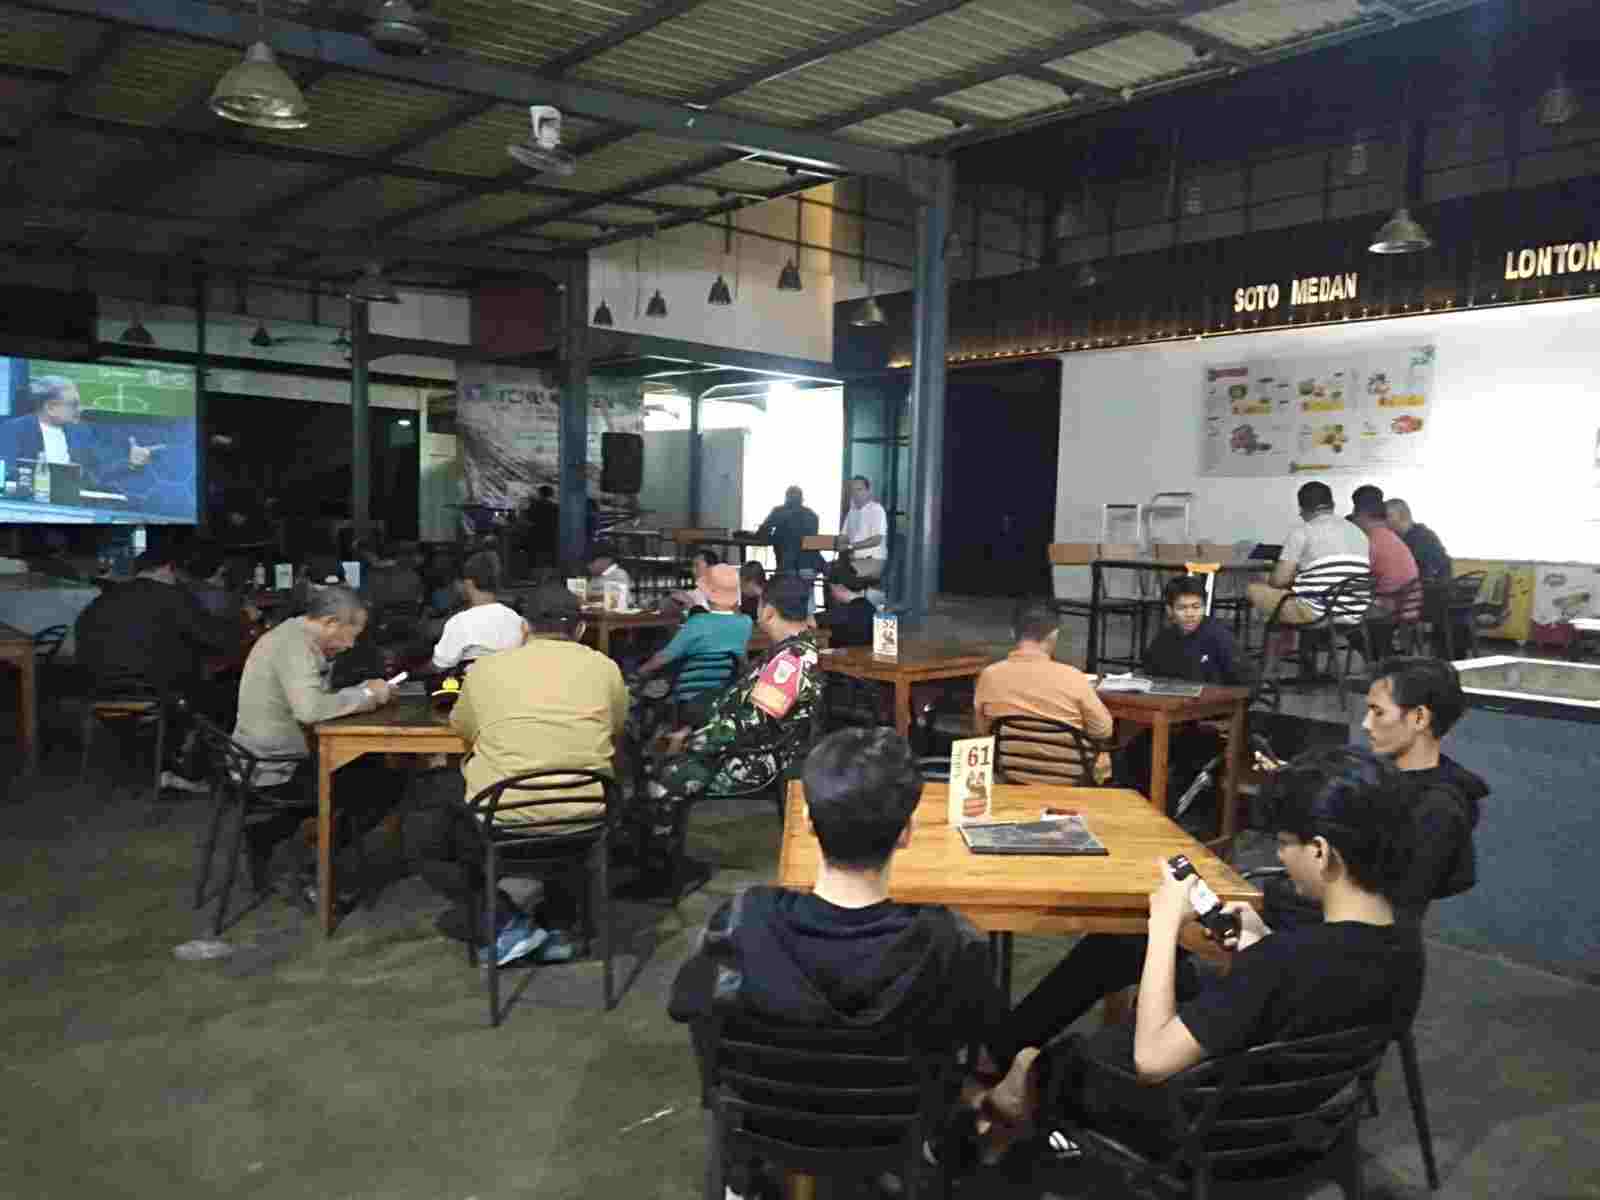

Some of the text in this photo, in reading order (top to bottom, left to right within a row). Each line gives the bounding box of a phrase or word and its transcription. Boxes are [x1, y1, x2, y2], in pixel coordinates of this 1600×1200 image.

[1234, 272, 1357, 312] SOTO MEDAN
[967, 745, 991, 767] 61
